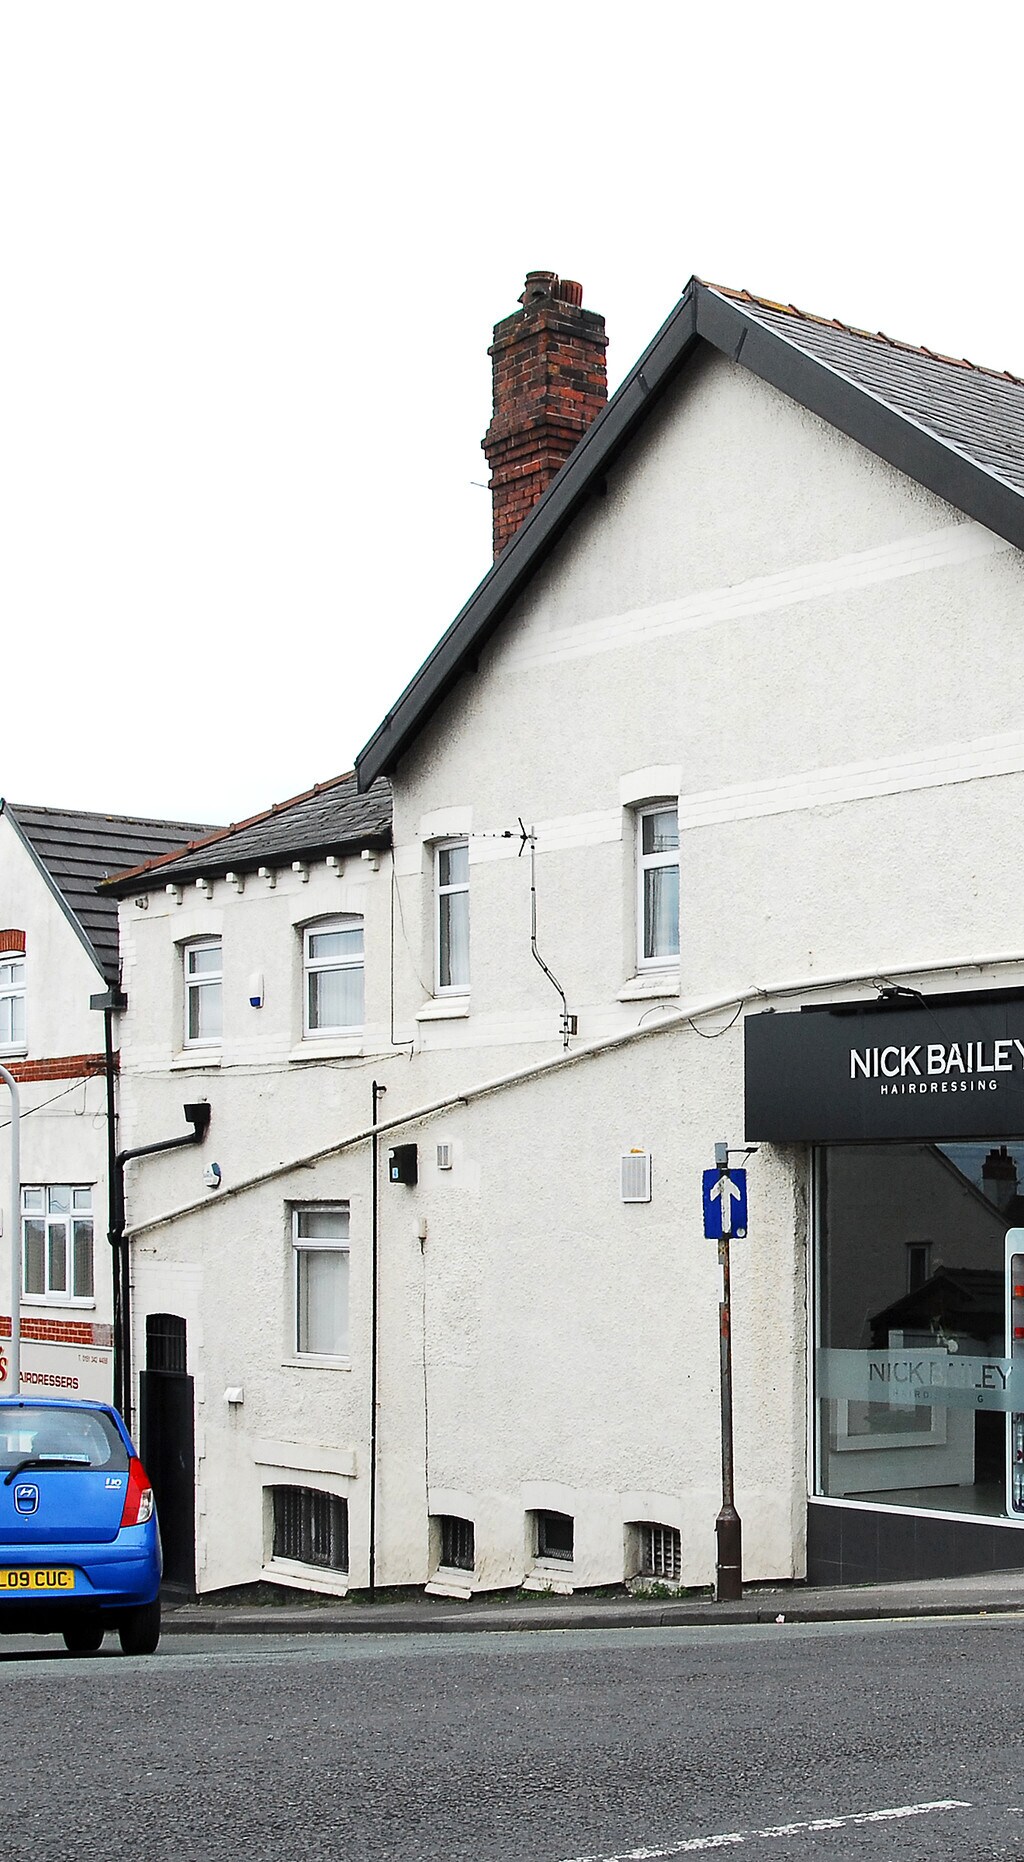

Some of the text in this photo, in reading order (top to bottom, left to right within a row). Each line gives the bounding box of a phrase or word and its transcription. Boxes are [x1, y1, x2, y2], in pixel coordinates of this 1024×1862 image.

[850, 1045, 922, 1079] NICK
[880, 1079, 999, 1095] HAIRDRESSING
[20, 1371, 79, 1389] AIRDRESSERS
[868, 1361, 924, 1384] NICK
[35, 1571, 68, 1587] CUC
